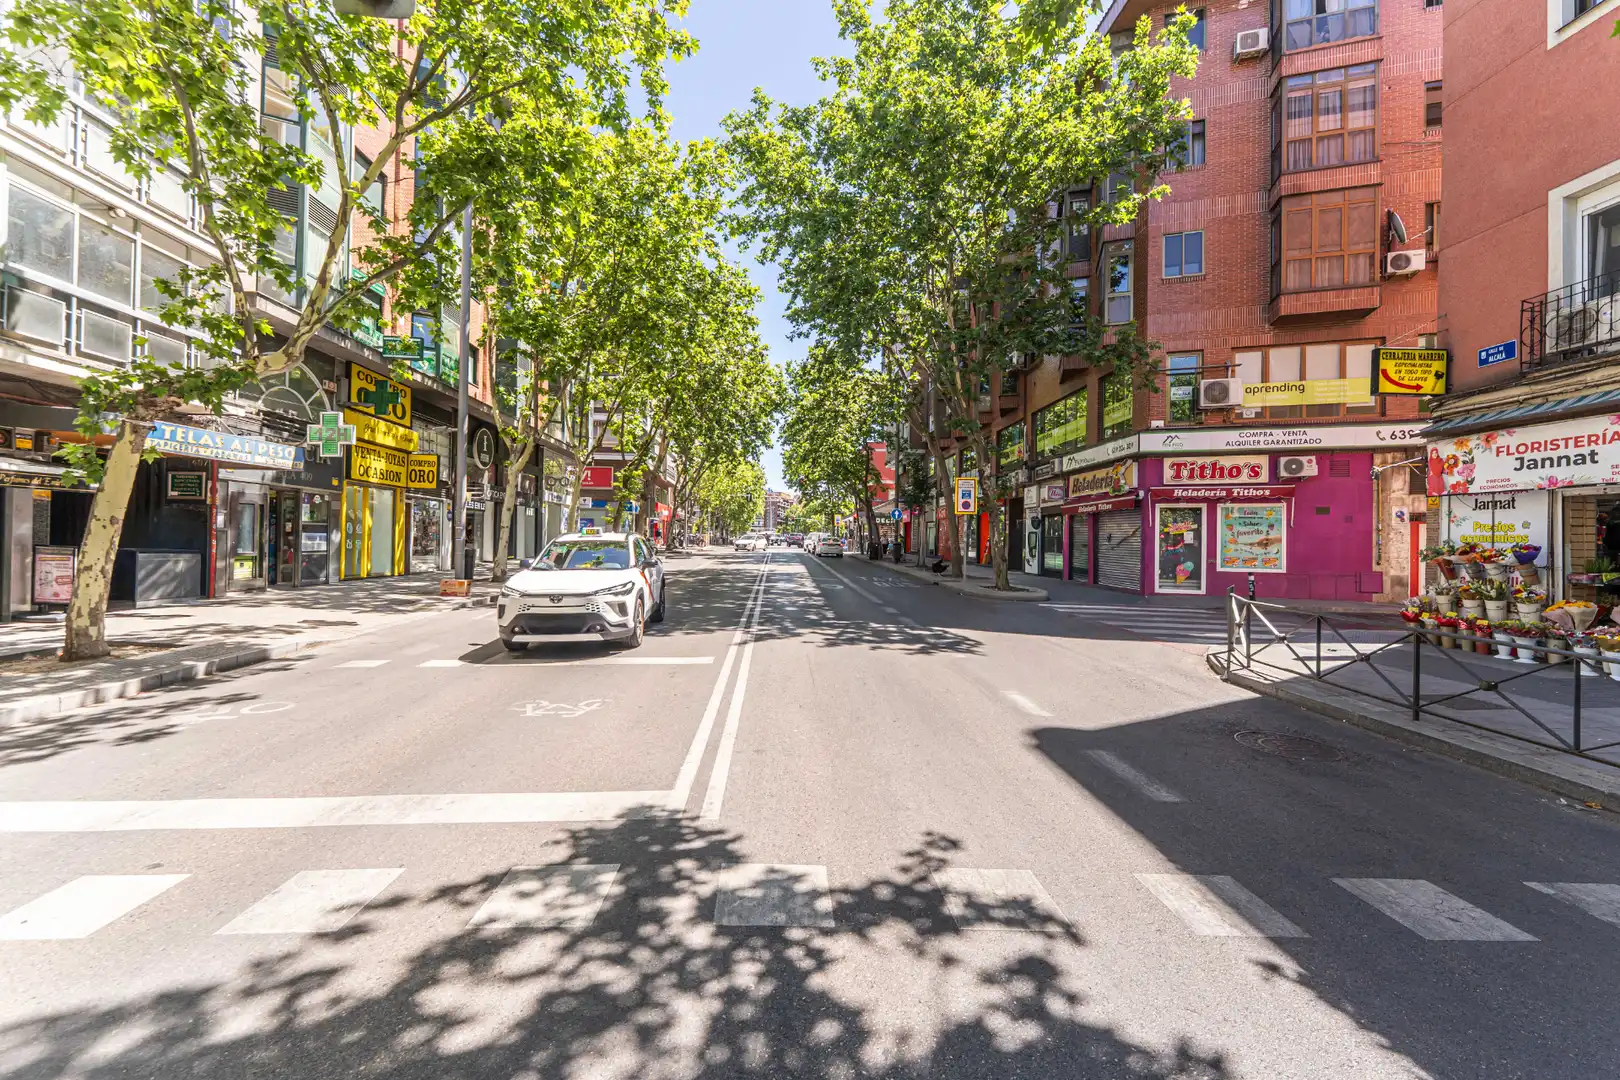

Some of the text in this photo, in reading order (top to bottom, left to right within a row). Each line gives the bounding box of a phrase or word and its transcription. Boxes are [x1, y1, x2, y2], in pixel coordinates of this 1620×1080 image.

[1418, 352, 1445, 361] MARRERO
[1244, 382, 1305, 396] aprending
[1238, 430, 1274, 438] COMPRA
[160, 425, 296, 458] TELAS AL PESO
[1225, 438, 1322, 447] ALQUILER GARANTIZADO
[409, 459, 436, 468] COMPRO
[1513, 449, 1599, 472] Jannat
[358, 464, 402, 482] OCASION
[1169, 459, 1263, 481] Titho's
[409, 469, 435, 484] ORO
[1173, 488, 1271, 497] Heladería Titho's
[1472, 496, 1516, 511] Jannat
[1473, 521, 1516, 532] Precios
[1237, 528, 1264, 538] favorito
